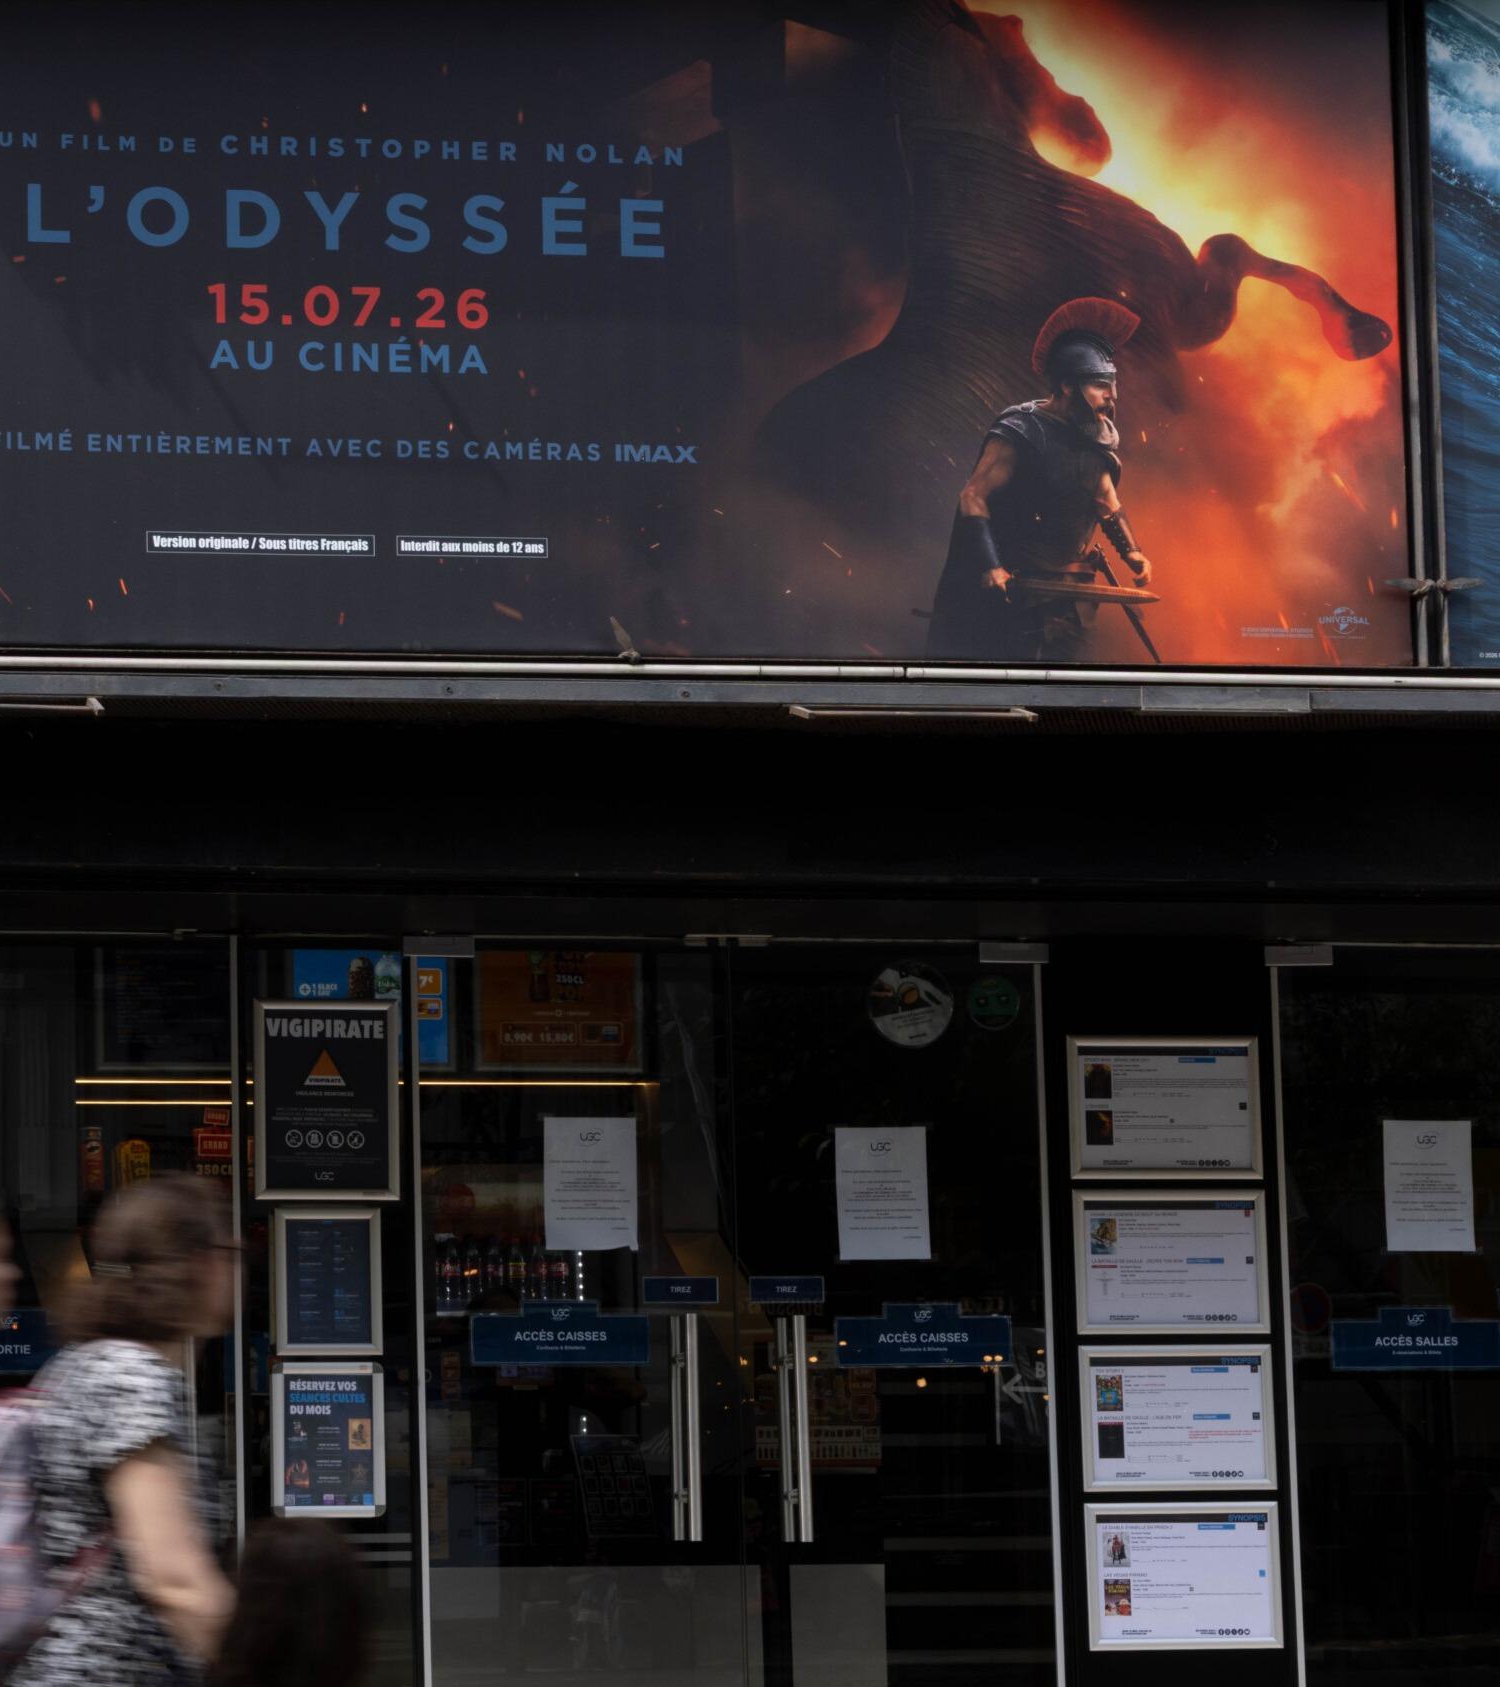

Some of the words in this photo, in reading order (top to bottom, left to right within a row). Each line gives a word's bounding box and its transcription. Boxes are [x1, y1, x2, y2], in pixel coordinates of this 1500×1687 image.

[61, 134, 136, 151] FILM
[158, 137, 198, 153] DE
[221, 135, 517, 161] CHRISTOPHER
[546, 144, 685, 166] NOLAN
[208, 283, 489, 330] 15.07.26
[209, 339, 275, 372] AU
[298, 336, 488, 376] CINÉMA
[86, 431, 290, 456] ENTIÈREMENT
[307, 437, 382, 459] AVEC
[397, 439, 449, 459] DES
[463, 439, 602, 462] CAMÉRAS
[614, 443, 698, 465] IMAX
[153, 535, 196, 548] Version
[199, 536, 249, 550] originale
[259, 537, 287, 550] Sous
[289, 538, 318, 551] titres
[320, 538, 369, 553] Français
[401, 540, 440, 551] Interdit
[442, 542, 460, 552] aux
[462, 542, 495, 553] moins
[497, 542, 510, 553] de
[512, 542, 523, 553] 12
[525, 543, 544, 554] ans
[1318, 616, 1370, 625] UNIVERSAL
[266, 1017, 384, 1040] VIGIPIRATE
[580, 1132, 602, 1142] UGC
[1417, 1135, 1438, 1145] UGC
[870, 1142, 892, 1152] UGC
[314, 1171, 335, 1182] UGC
[670, 1286, 692, 1294] TIREZ
[776, 1286, 798, 1294] TIREZ
[551, 1307, 571, 1318] UGC
[914, 1310, 933, 1320] UGC
[1406, 1313, 1426, 1323] UGC
[557, 1331, 608, 1342] CAISSES
[878, 1331, 917, 1344] ACCÈS
[920, 1332, 970, 1344] CAISSES
[1374, 1334, 1413, 1347] ACCÈS
[1415, 1336, 1460, 1347] SALLES
[290, 1379, 336, 1391] RÉSERVEZ
[337, 1381, 357, 1391] VOS
[290, 1405, 304, 1415] DU
[305, 1405, 332, 1415] MOIS
[1228, 1513, 1267, 1523] SYNOPSIS
